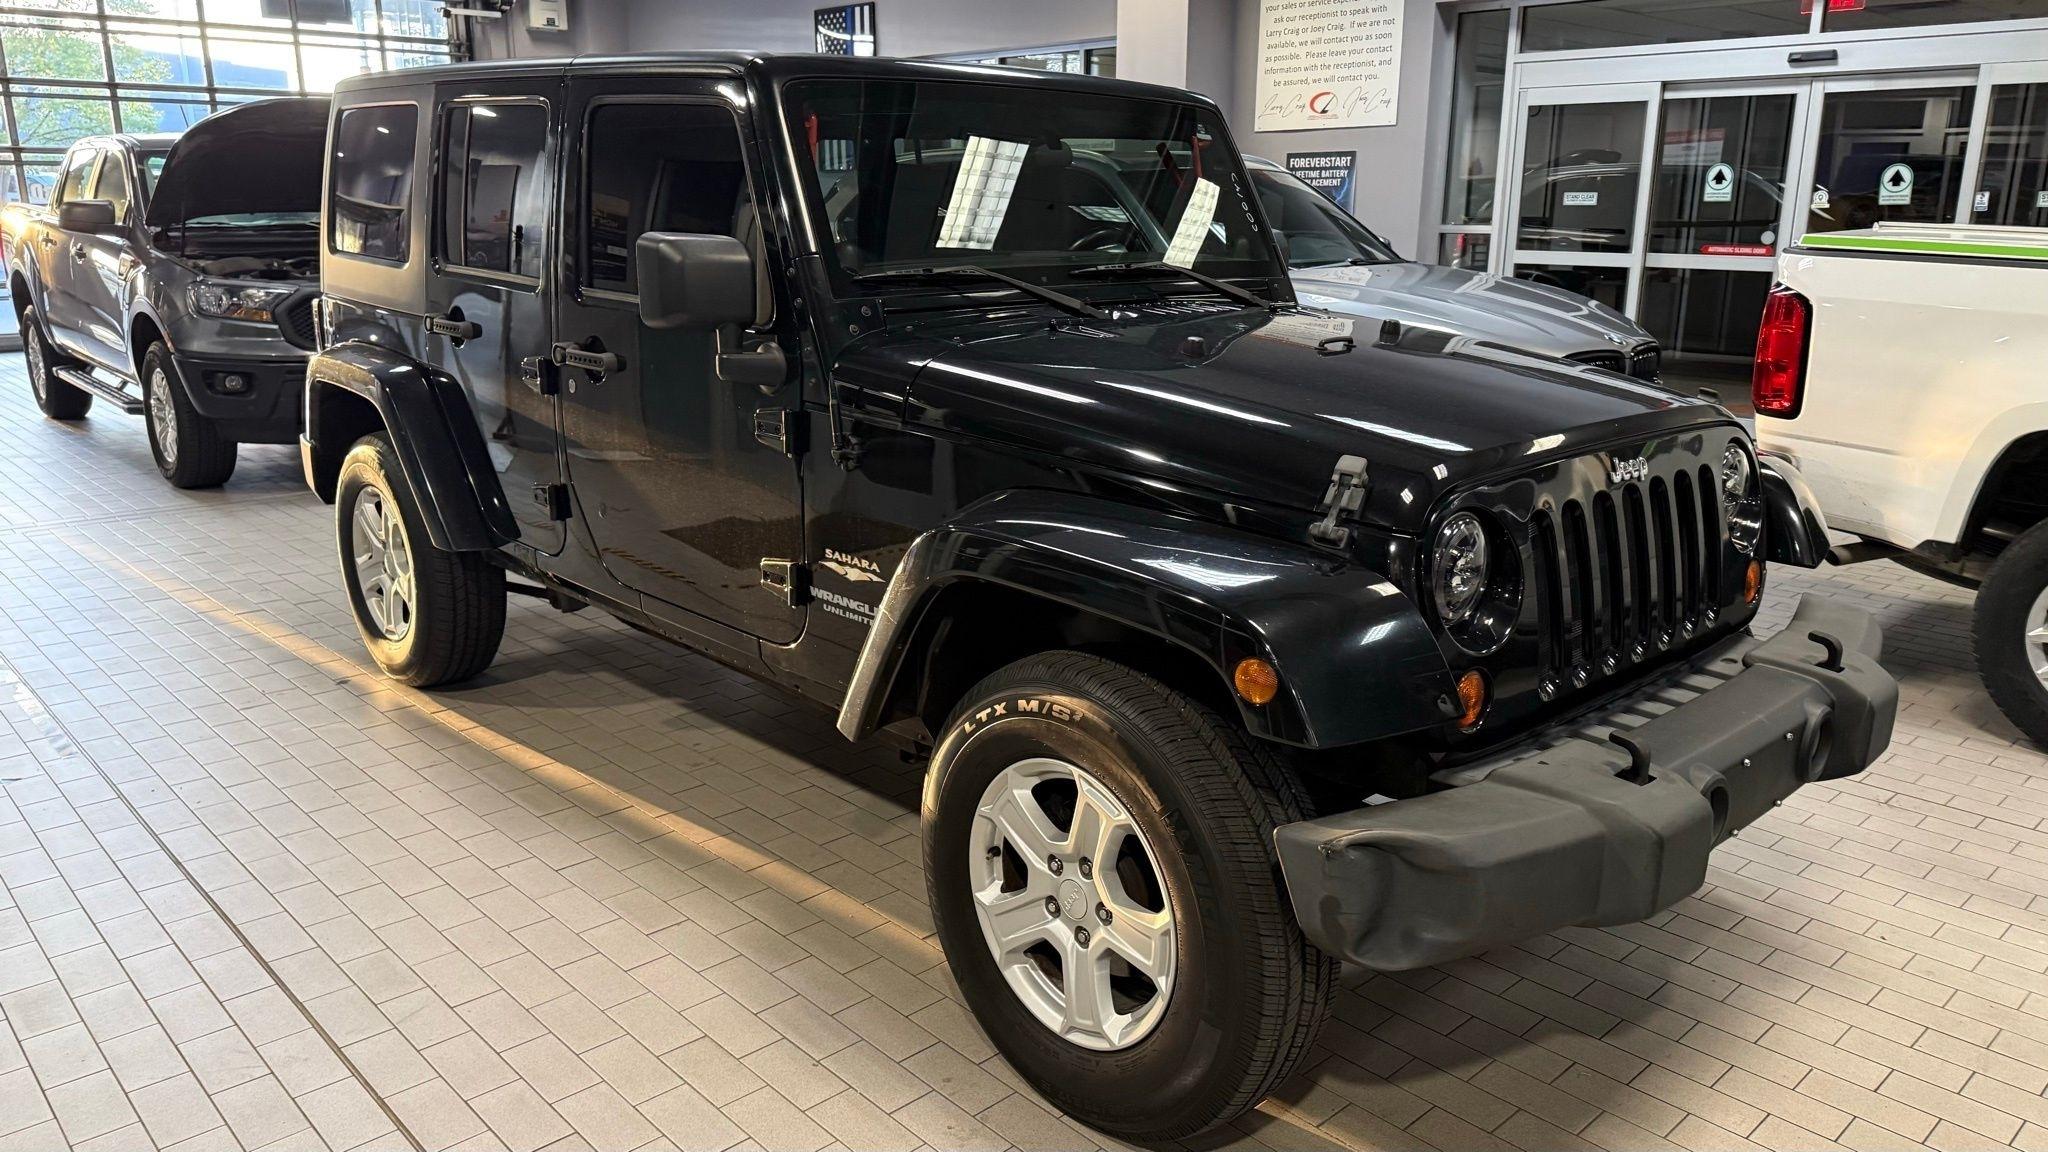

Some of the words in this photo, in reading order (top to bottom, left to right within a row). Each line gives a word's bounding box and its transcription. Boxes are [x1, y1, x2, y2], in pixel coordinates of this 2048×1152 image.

[1265, 5, 1279, 13] your
[1281, 2, 1297, 10] sales
[1298, 10, 1338, 21] receptionist
[1349, 6, 1370, 17] speak
[1371, 4, 1388, 13] with
[1265, 29, 1282, 37] Larry
[1283, 27, 1300, 36] Craig
[1310, 25, 1325, 34] Joey
[1382, 18, 1395, 26] not
[1267, 41, 1297, 49] available,
[1310, 37, 1323, 45] will
[1323, 35, 1349, 44] contact
[1350, 35, 1363, 43] you
[1374, 32, 1393, 40] soon
[1273, 52, 1302, 63] possible.
[1305, 51, 1327, 59] Please
[1328, 49, 1347, 57] leave
[1348, 48, 1364, 57] your
[1365, 45, 1393, 54] contact
[1264, 66, 1302, 75] information
[1303, 63, 1319, 72] with
[1319, 62, 1332, 70] the
[1332, 59, 1377, 70] receptionist,
[1378, 57, 1392, 66] and
[1273, 79, 1282, 87] be
[1282, 77, 1310, 86] assured,
[1323, 74, 1336, 83] will
[1336, 74, 1363, 82] contact
[1364, 73, 1380, 82] you.
[1290, 156, 1352, 168] FOREVERSTART
[1321, 169, 1349, 177] BATTERY
[1610, 457, 1648, 483] Jeep
[825, 548, 880, 573] SAHARA
[963, 702, 1007, 734] LTX
